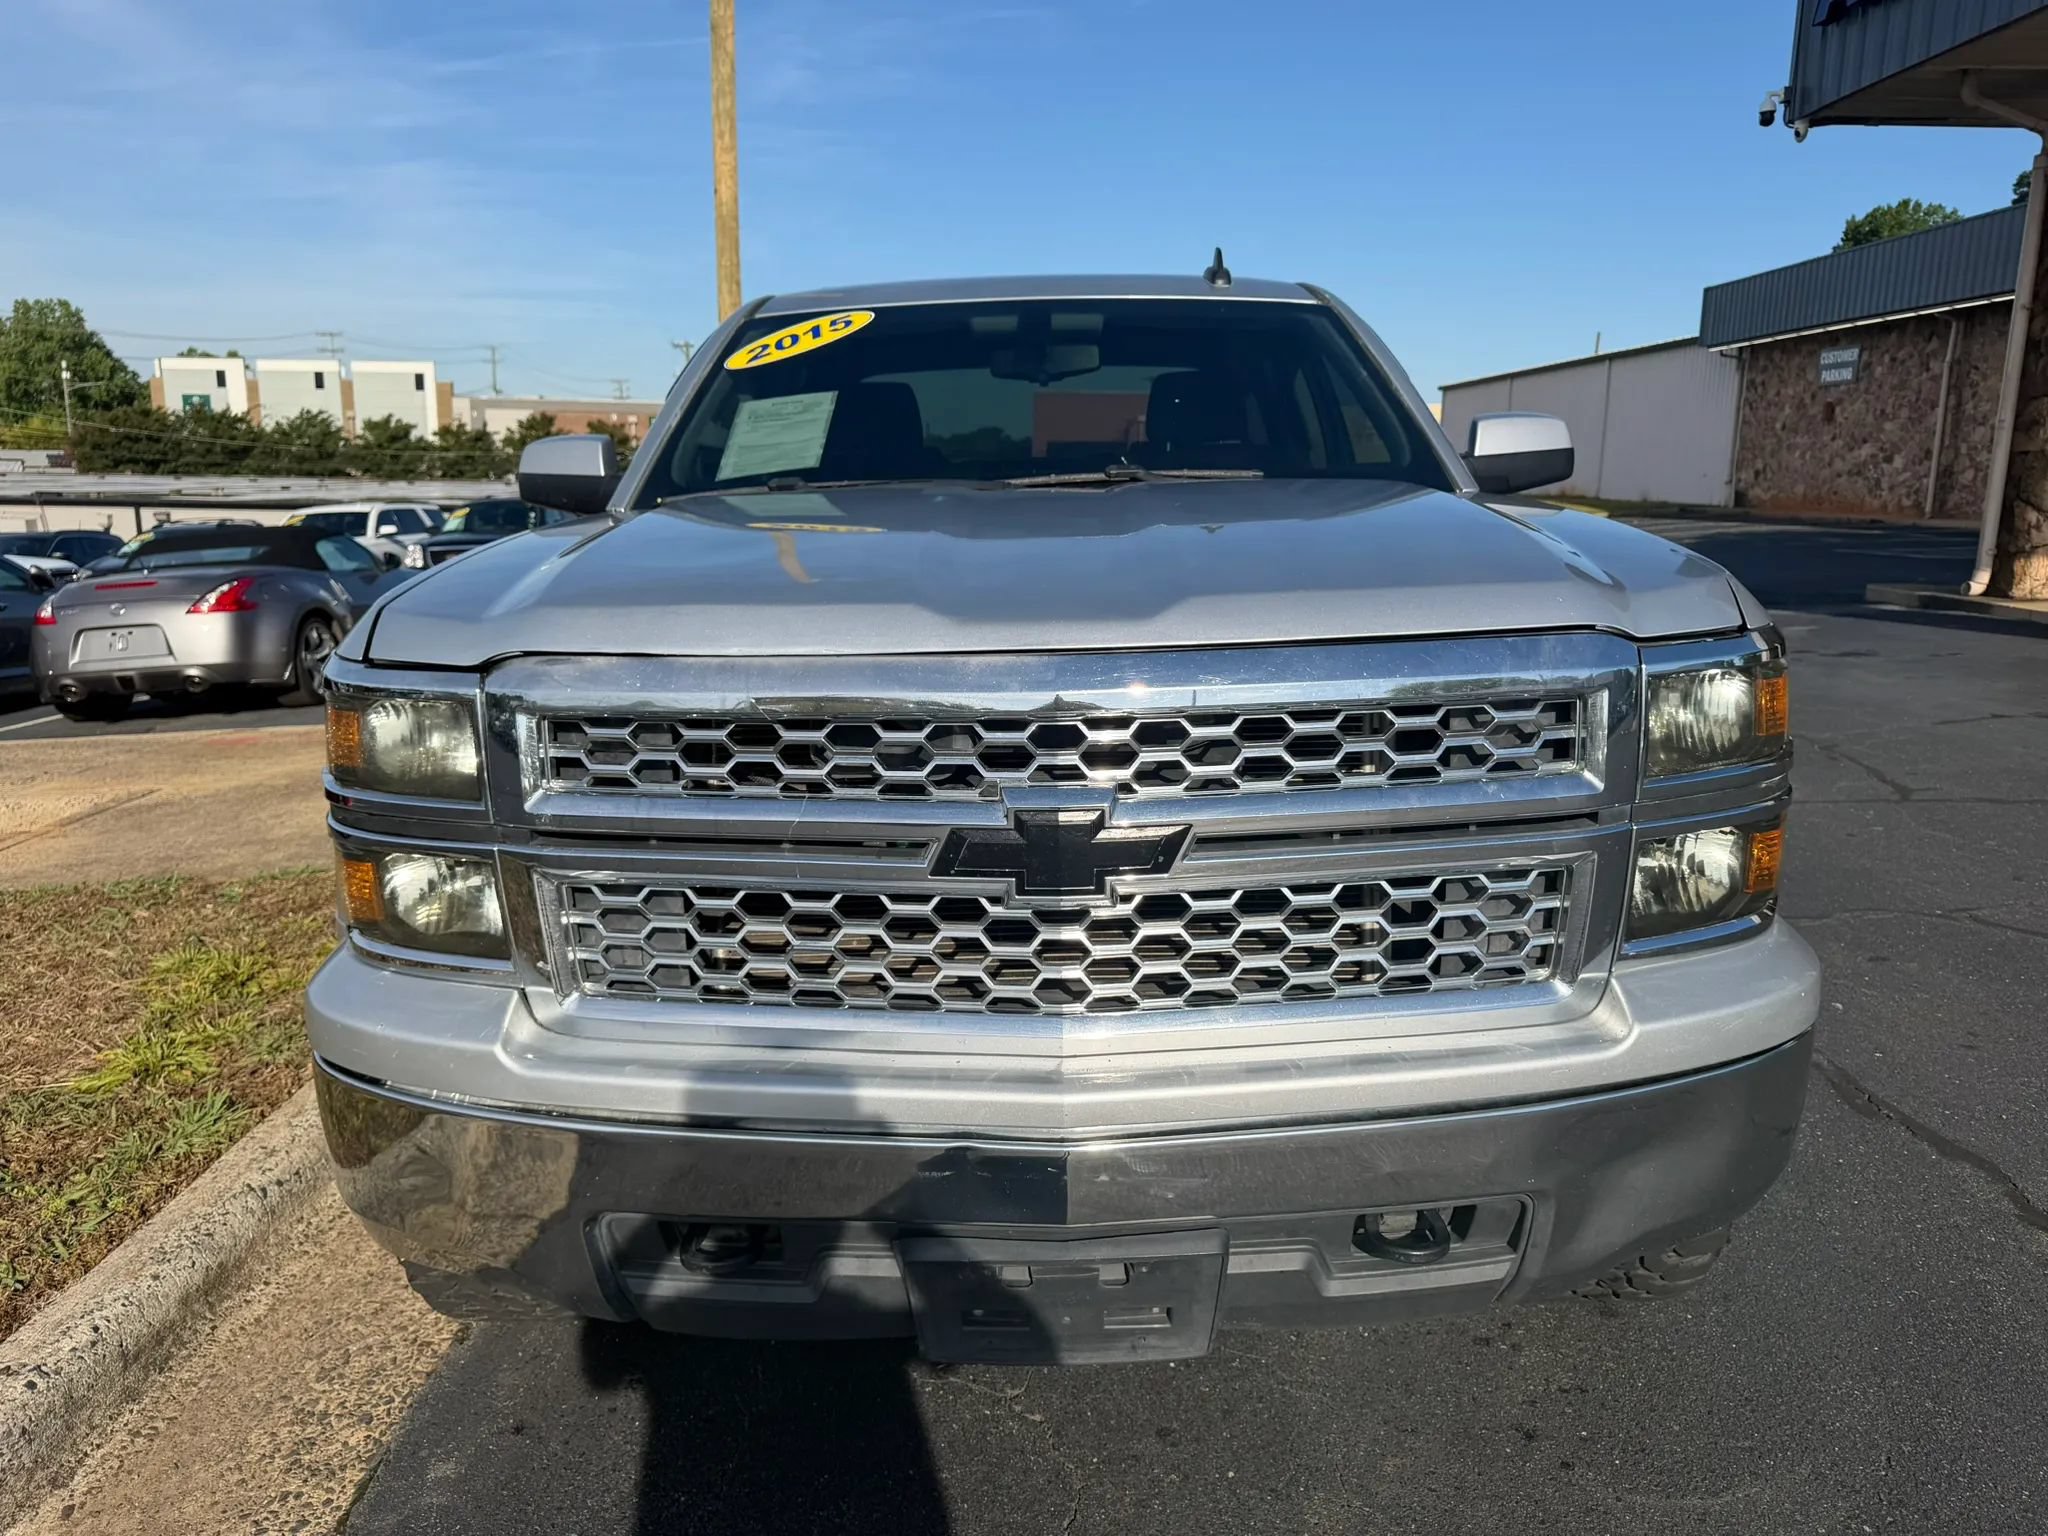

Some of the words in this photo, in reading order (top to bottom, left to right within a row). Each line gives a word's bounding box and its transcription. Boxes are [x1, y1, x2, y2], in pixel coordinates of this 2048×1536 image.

[746, 315, 853, 364] 2015
[1820, 348, 1860, 365] CUSTOMER
[1821, 367, 1853, 384] PARKING
